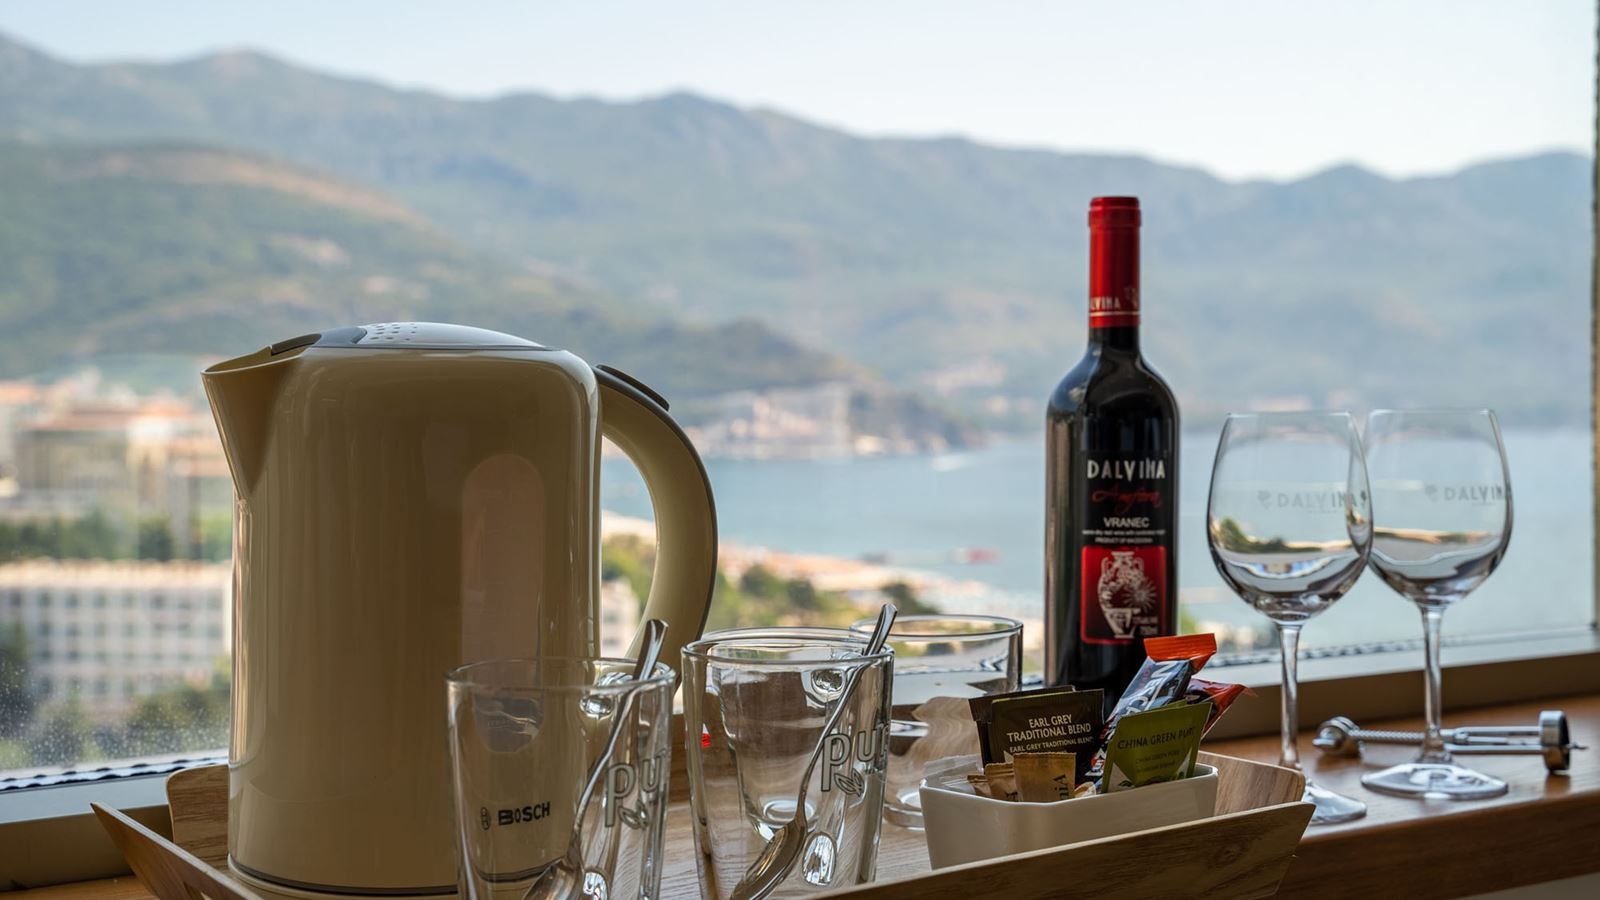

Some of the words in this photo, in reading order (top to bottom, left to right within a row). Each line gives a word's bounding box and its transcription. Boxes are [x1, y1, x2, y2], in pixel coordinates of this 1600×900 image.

[1087, 458, 1166, 482] DALVINA
[1103, 516, 1150, 528] VRANEC
[1028, 717, 1051, 729] EARL
[1050, 714, 1072, 726] GREY
[1006, 726, 1067, 742] TRADITIONAL
[1067, 723, 1092, 736] BLEND
[1117, 736, 1148, 750] CHINA
[1150, 732, 1176, 746] GREEN
[1009, 744, 1026, 753] EARL
[1026, 742, 1042, 751] GREY
[1042, 738, 1077, 749] TRADITIONAL
[498, 801, 551, 826] BOSCH
